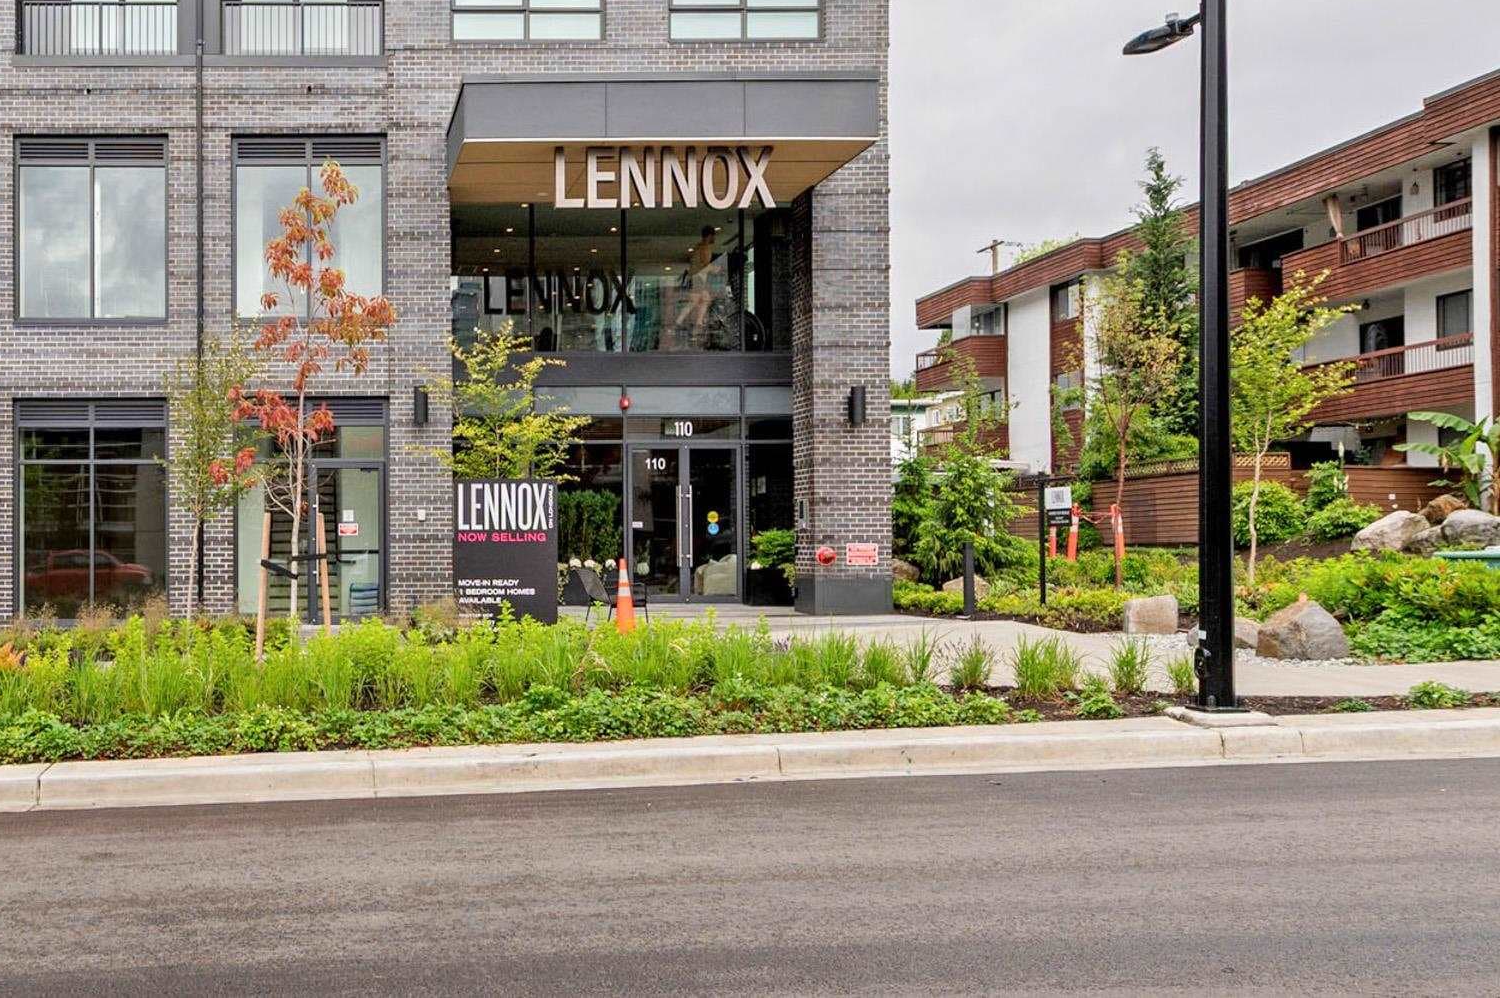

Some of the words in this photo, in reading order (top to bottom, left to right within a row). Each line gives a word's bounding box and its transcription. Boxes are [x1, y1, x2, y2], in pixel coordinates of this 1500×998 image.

[555, 146, 777, 209] LENNOX
[484, 266, 638, 315] LENNOX
[674, 421, 693, 437] 110
[645, 458, 666, 470] 110
[457, 482, 548, 531] LENNOX
[457, 532, 487, 542] NOW
[492, 532, 547, 542] SELLING
[458, 579, 491, 587] MOVE-IN
[492, 579, 520, 587] READY
[465, 588, 506, 596] BEDROOM
[507, 588, 536, 596] HOMES
